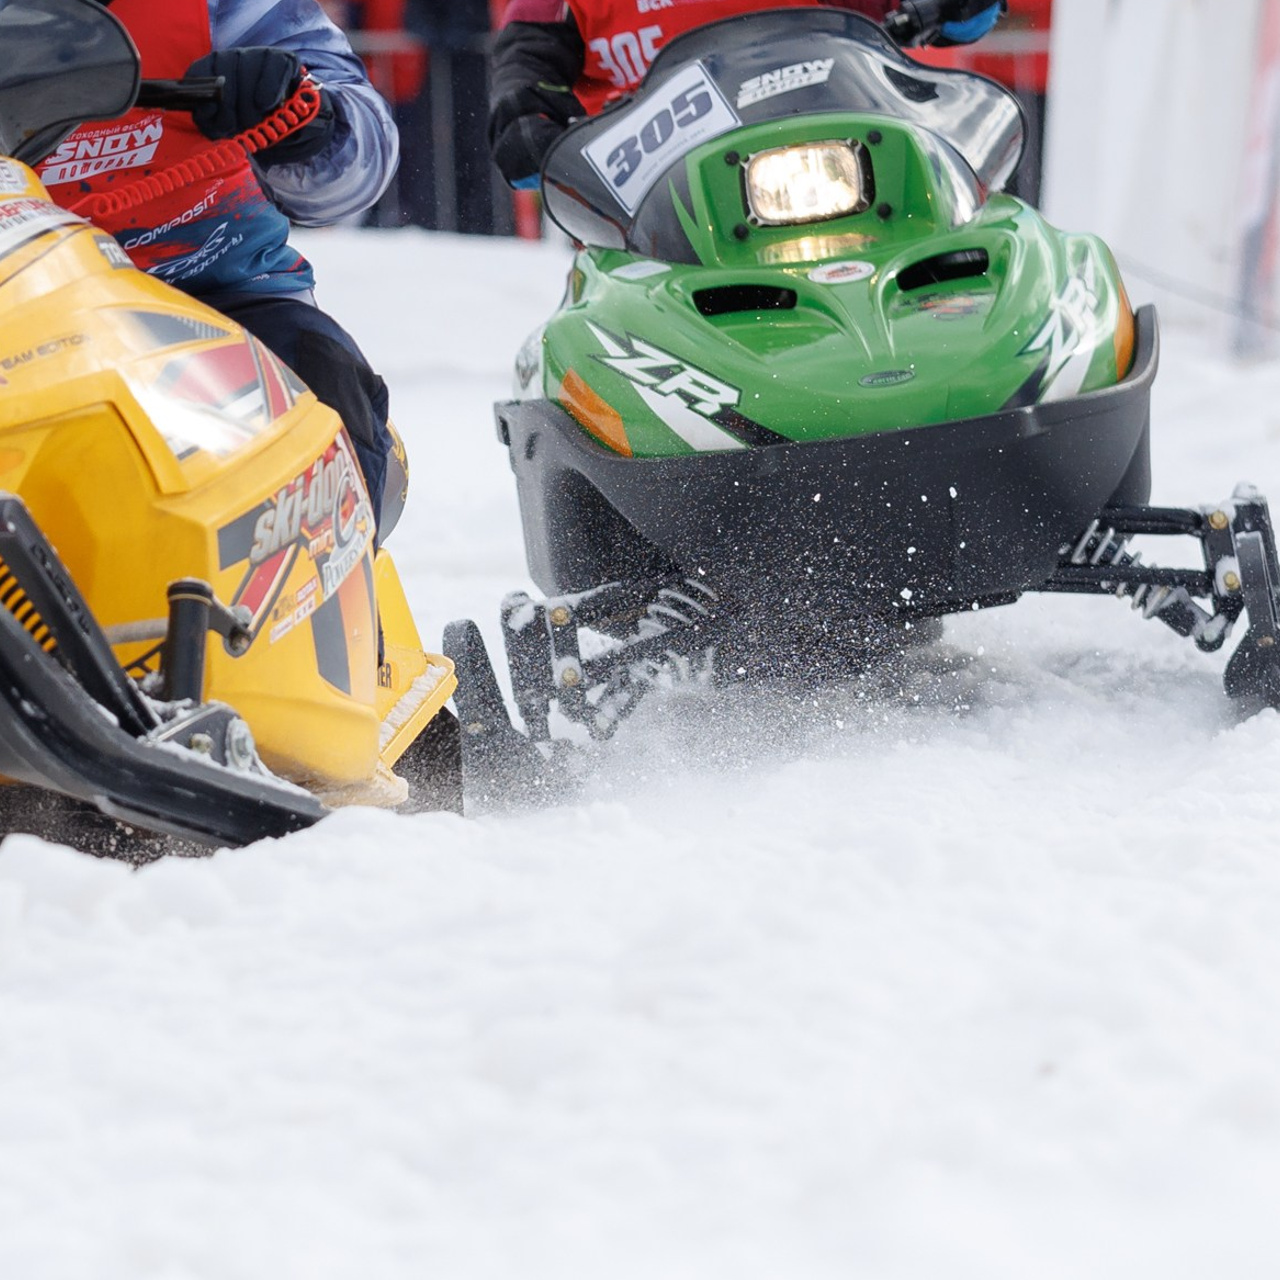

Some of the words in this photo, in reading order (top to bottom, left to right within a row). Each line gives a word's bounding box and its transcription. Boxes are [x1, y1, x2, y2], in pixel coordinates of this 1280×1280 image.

[46, 117, 164, 165] SNOW
[605, 80, 714, 188] 305
[58, 152, 139, 180] ПОМОРЬЕ
[124, 190, 218, 250] COMPOSIT
[166, 233, 243, 284] ragonfly
[587, 330, 743, 418] ZR
